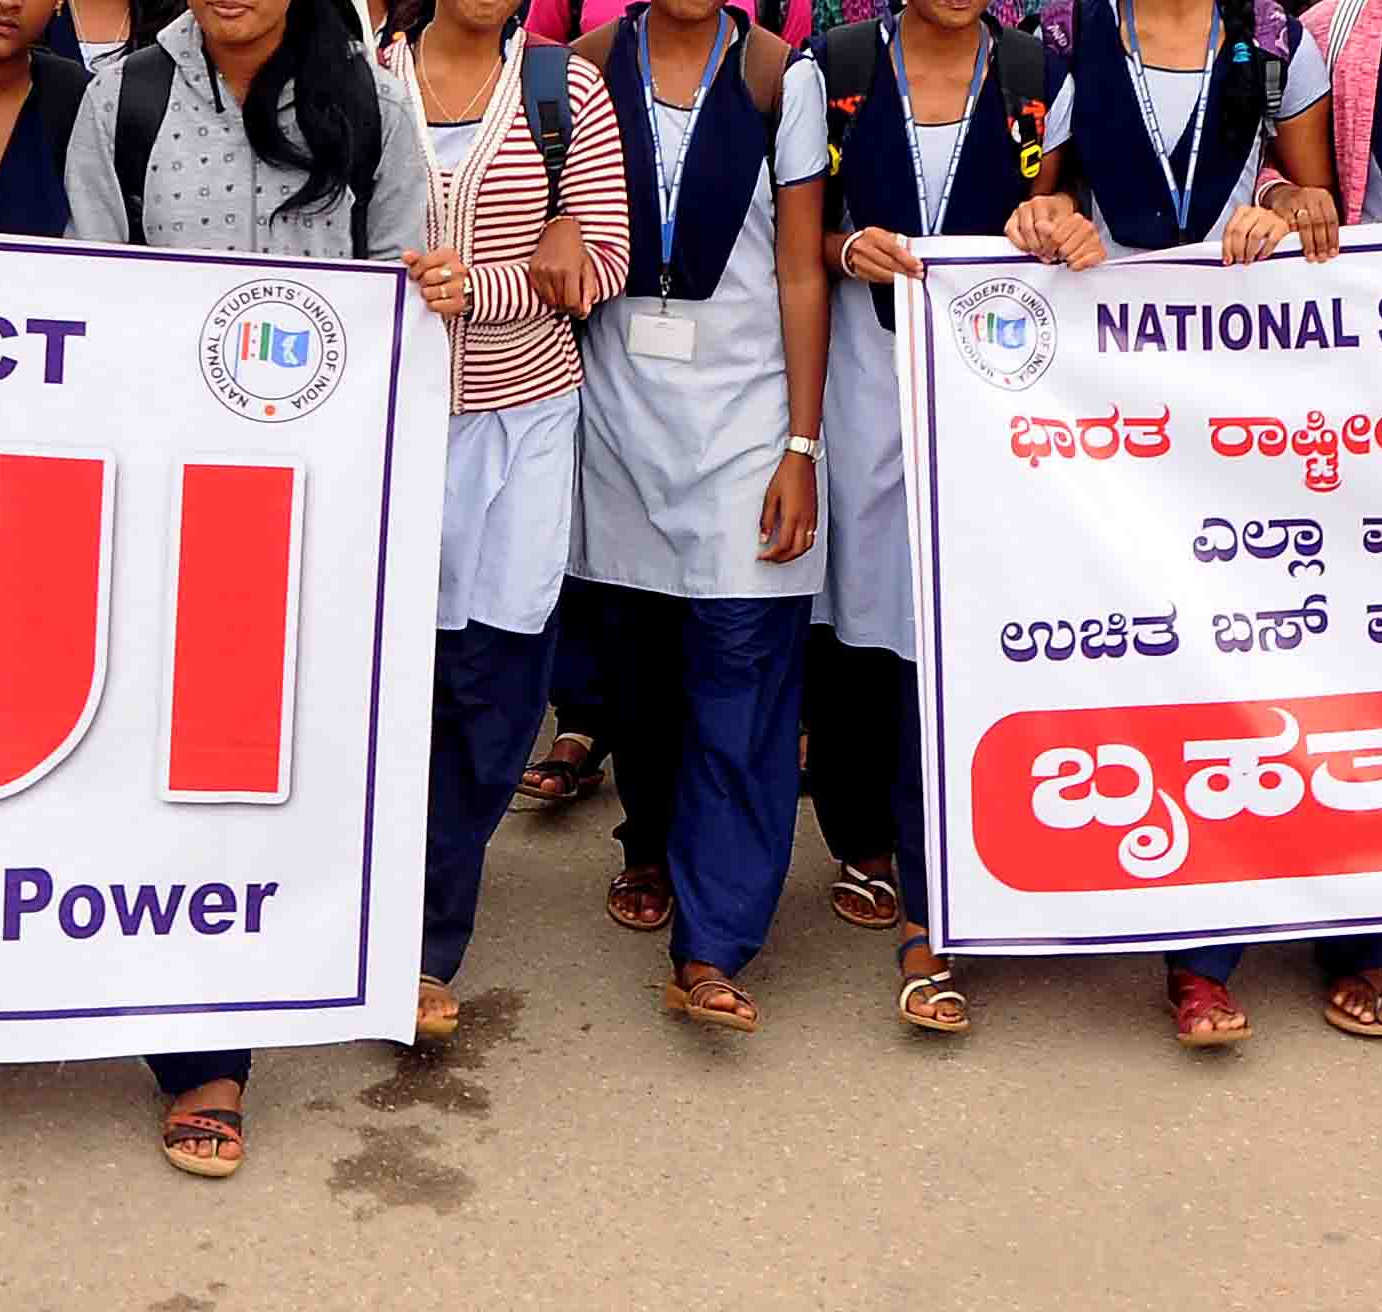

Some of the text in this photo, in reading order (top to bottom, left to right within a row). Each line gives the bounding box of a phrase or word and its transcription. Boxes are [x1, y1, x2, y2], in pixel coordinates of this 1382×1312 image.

[303, 297, 337, 344] UNION
[1021, 291, 1049, 327] UNION
[1097, 297, 1359, 353] NATIONAL
[207, 334, 249, 409] NATIONAL
[326, 350, 339, 372] OF
[291, 375, 330, 409] INDIA
[1010, 403, 1172, 469] ಭಾರತ
[1192, 516, 1325, 577] ಎಲ್ಲಾ
[1000, 600, 1180, 663] ಉಚಿತ
[1211, 593, 1330, 653] ಬಸ್
[3, 868, 279, 942] Power
